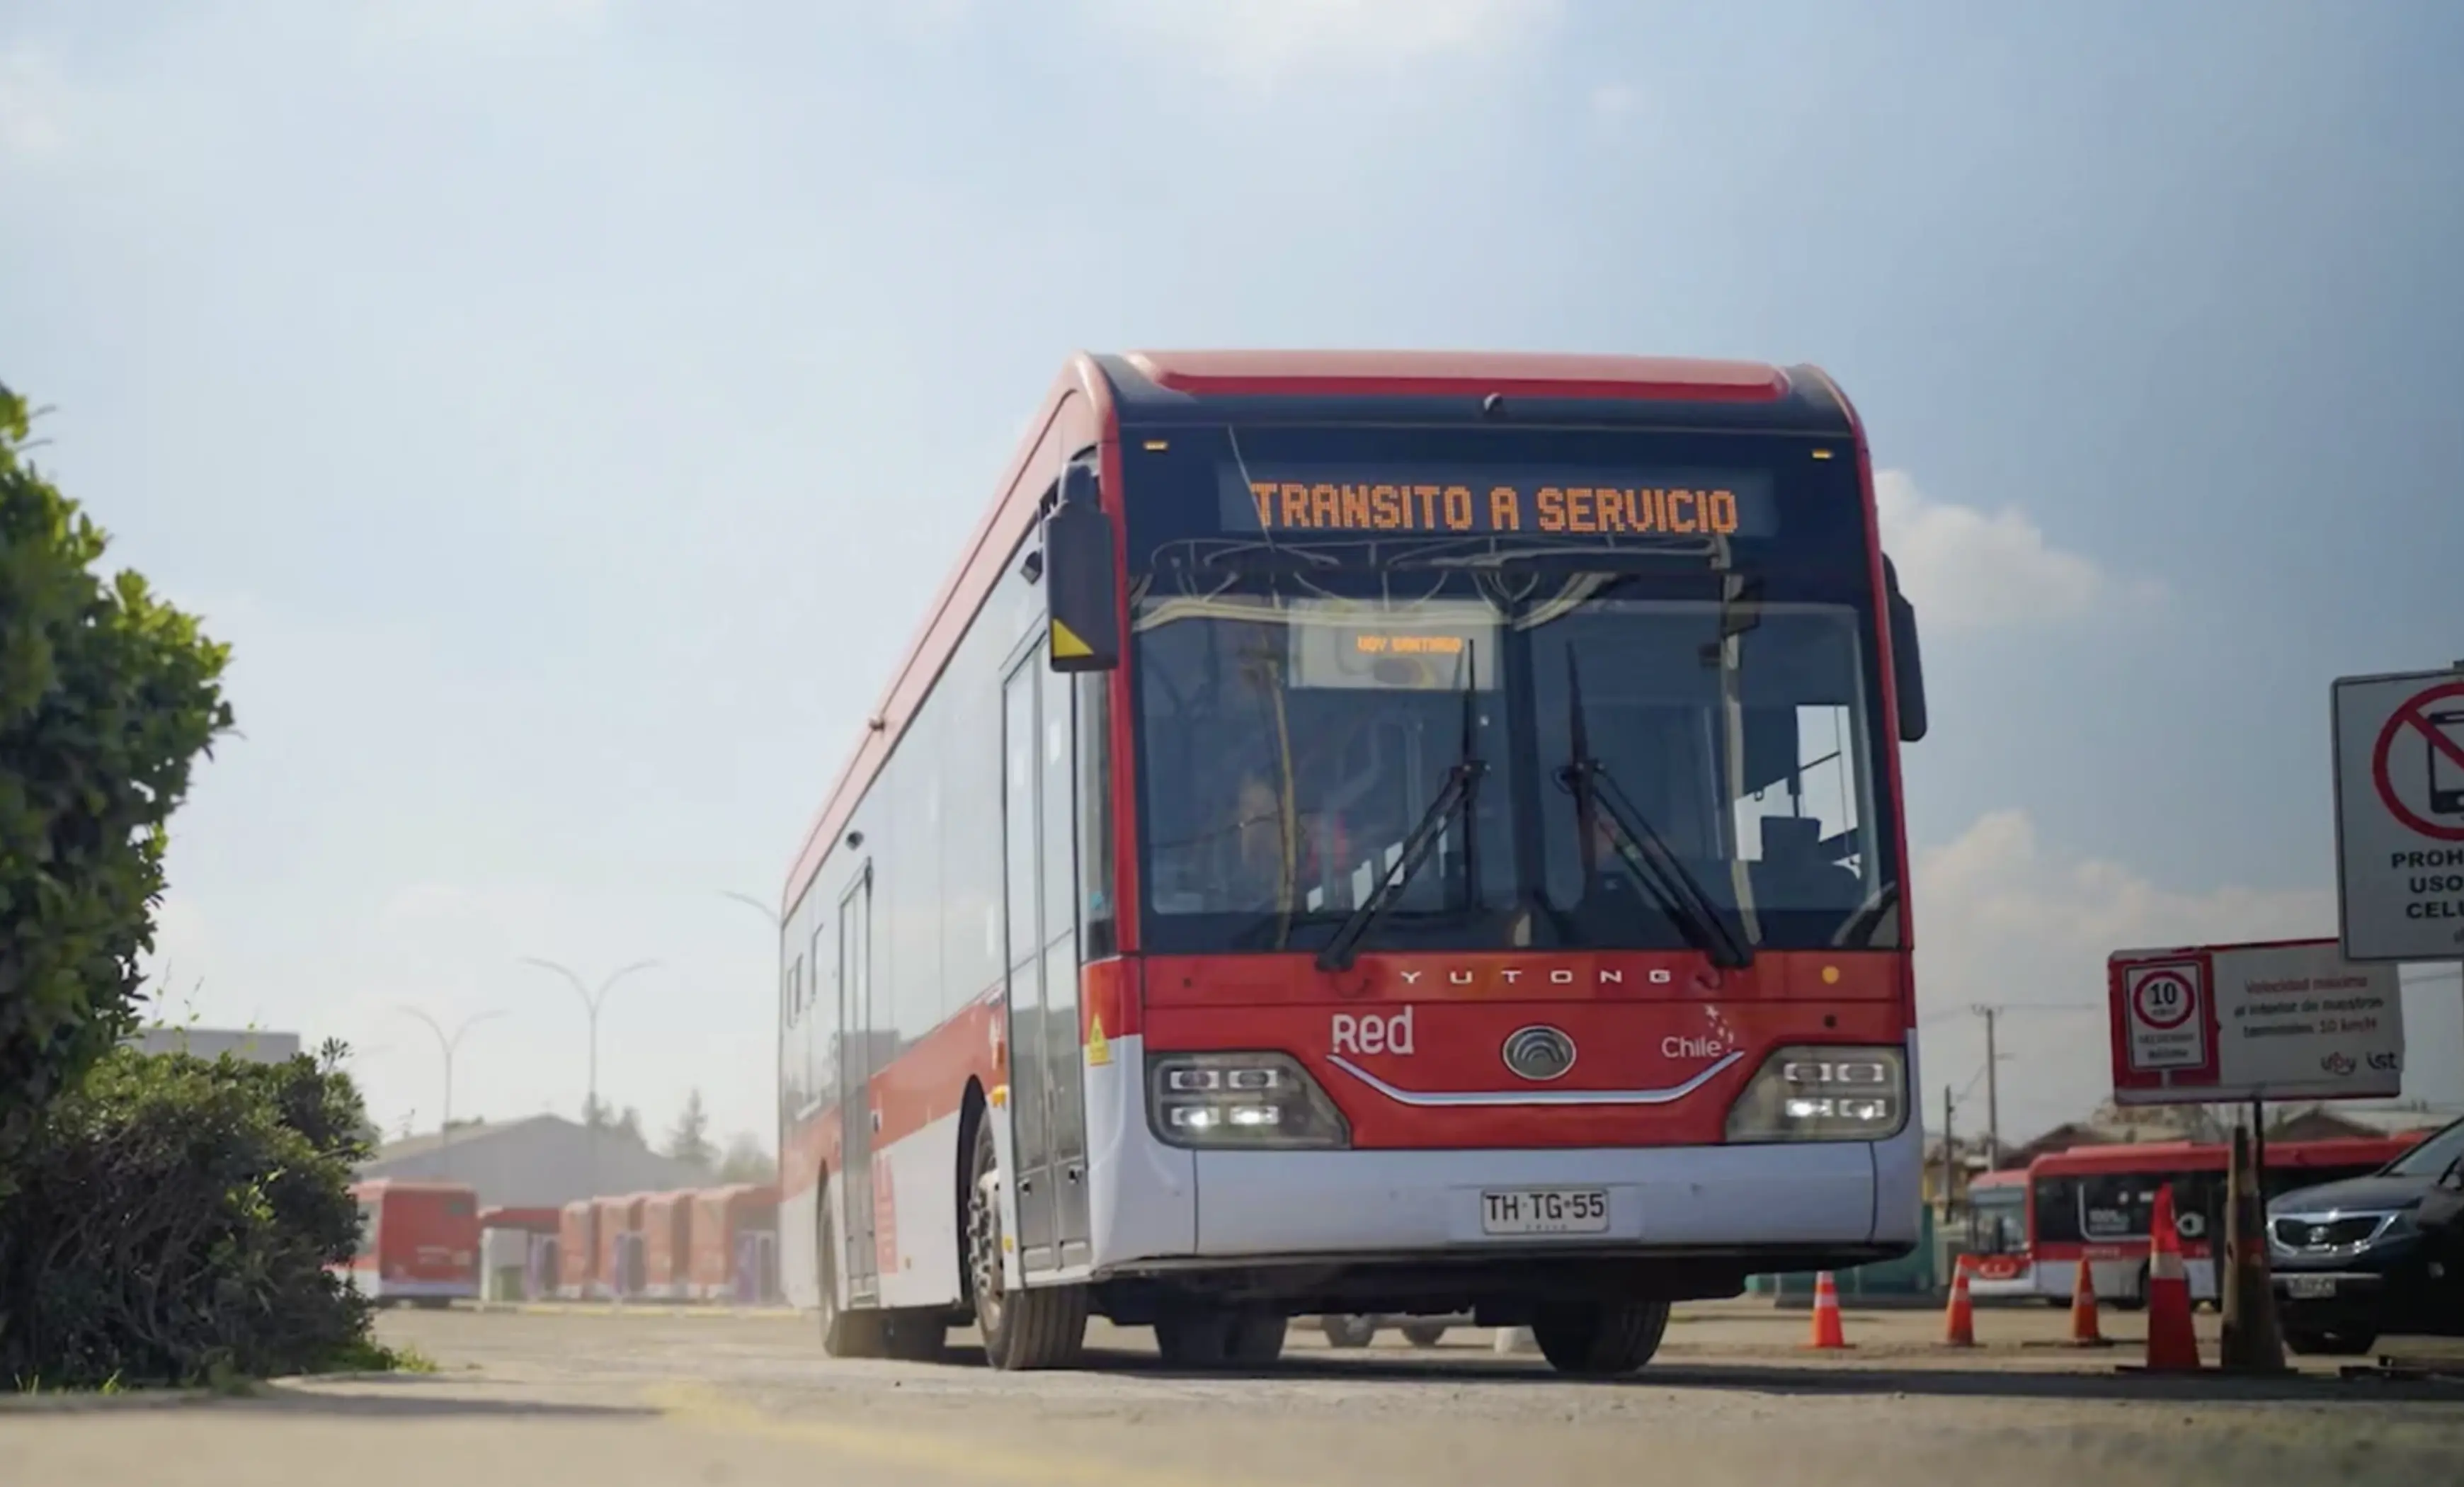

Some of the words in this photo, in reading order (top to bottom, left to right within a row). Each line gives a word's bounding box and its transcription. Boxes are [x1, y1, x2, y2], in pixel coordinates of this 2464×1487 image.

[1250, 483, 1472, 530] TRANSITO
[1490, 486, 1519, 531] A
[1537, 488, 1738, 532] SERVICIO
[2409, 874, 2463, 894] USO
[1401, 969, 1671, 984] YUTONG
[2150, 981, 2177, 1005] 10
[1333, 1004, 1415, 1054] Red
[2320, 1020, 2337, 1034] 10
[1661, 1035, 1722, 1058] Chile
